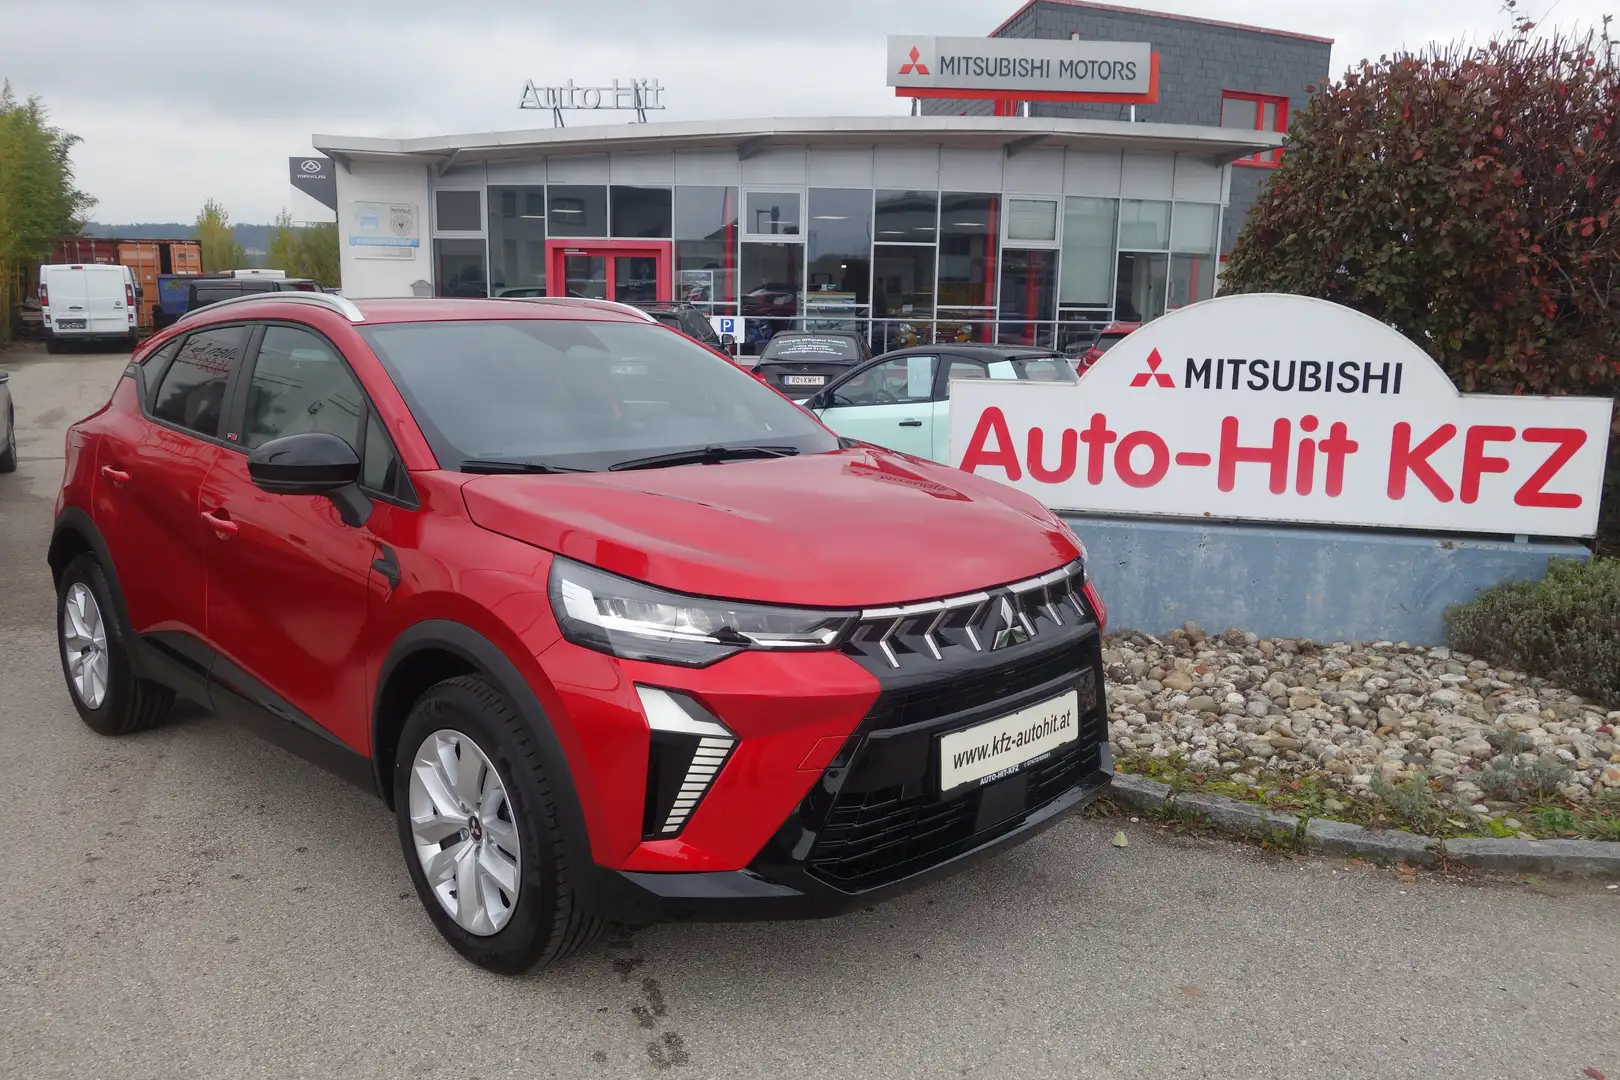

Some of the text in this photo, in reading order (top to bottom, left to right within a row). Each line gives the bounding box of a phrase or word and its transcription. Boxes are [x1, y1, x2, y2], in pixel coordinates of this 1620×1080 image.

[940, 56, 1137, 81] MITSUBISHI MOTORS
[518, 78, 665, 109] Auto Hit
[723, 320, 732, 332] P
[1185, 358, 1403, 394] MITSUBISHI
[958, 406, 1588, 509] Auto-Hit KFZ
[953, 707, 1071, 770] www.kfz-autohit.at
[979, 763, 1020, 786] AUTO-HIT-KFZ
